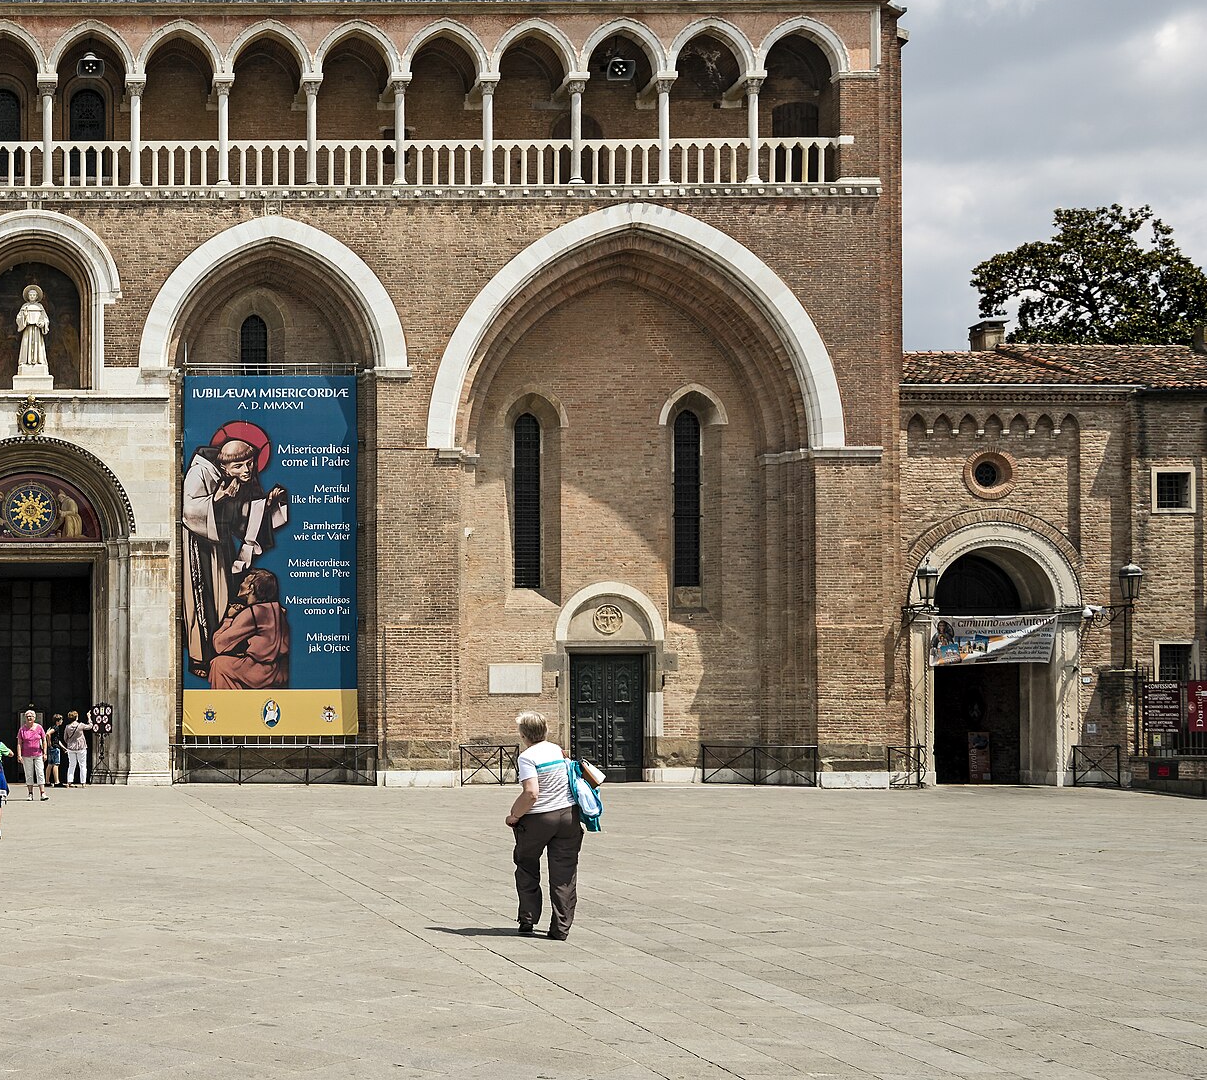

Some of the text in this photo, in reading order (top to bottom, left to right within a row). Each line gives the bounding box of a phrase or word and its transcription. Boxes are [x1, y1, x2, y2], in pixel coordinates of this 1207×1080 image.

[193, 388, 349, 398] IUBILÆUM MISERICORDIÆ
[278, 444, 349, 454] Misericordiosi
[312, 456, 317, 466] il
[322, 456, 349, 466] Padre
[314, 484, 349, 492] Merciful
[292, 495, 350, 503] like the Father
[304, 521, 349, 531] Barmherzig
[312, 532, 325, 540] der
[327, 532, 350, 540] Vater
[288, 558, 350, 567] Miséricordieux
[323, 569, 329, 577] le
[333, 569, 349, 577] Père
[286, 596, 350, 604] Misericordiosos
[337, 606, 349, 614] Pai
[307, 633, 349, 641] Miłosierni
[324, 643, 350, 653] Ojciec
